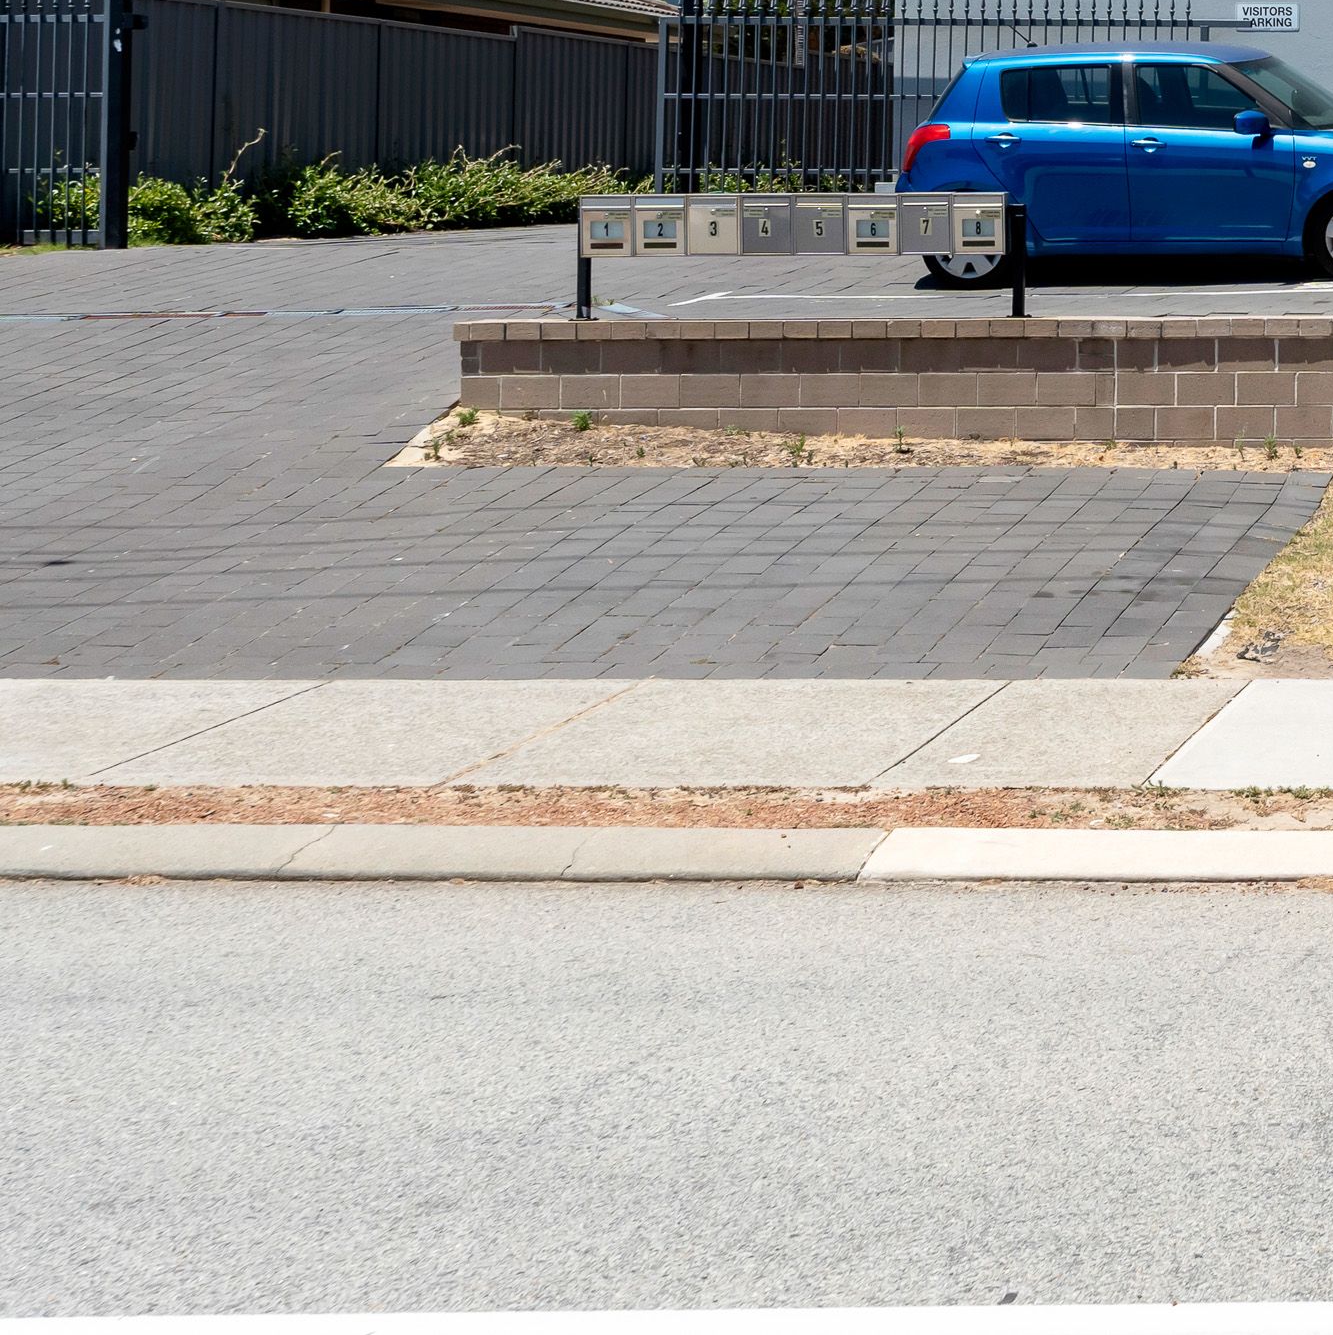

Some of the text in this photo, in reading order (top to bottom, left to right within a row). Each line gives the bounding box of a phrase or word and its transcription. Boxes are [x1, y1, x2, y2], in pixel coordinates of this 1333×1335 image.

[1242, 6, 1293, 16] VISITORS
[1242, 17, 1293, 27] ARKING
[604, 222, 609, 237] 1
[657, 222, 664, 237] 2
[710, 221, 717, 236] 3
[761, 220, 769, 235] 4
[815, 221, 823, 236] 5
[870, 222, 876, 236] 6
[922, 219, 929, 234] 7
[975, 221, 982, 235] 8
